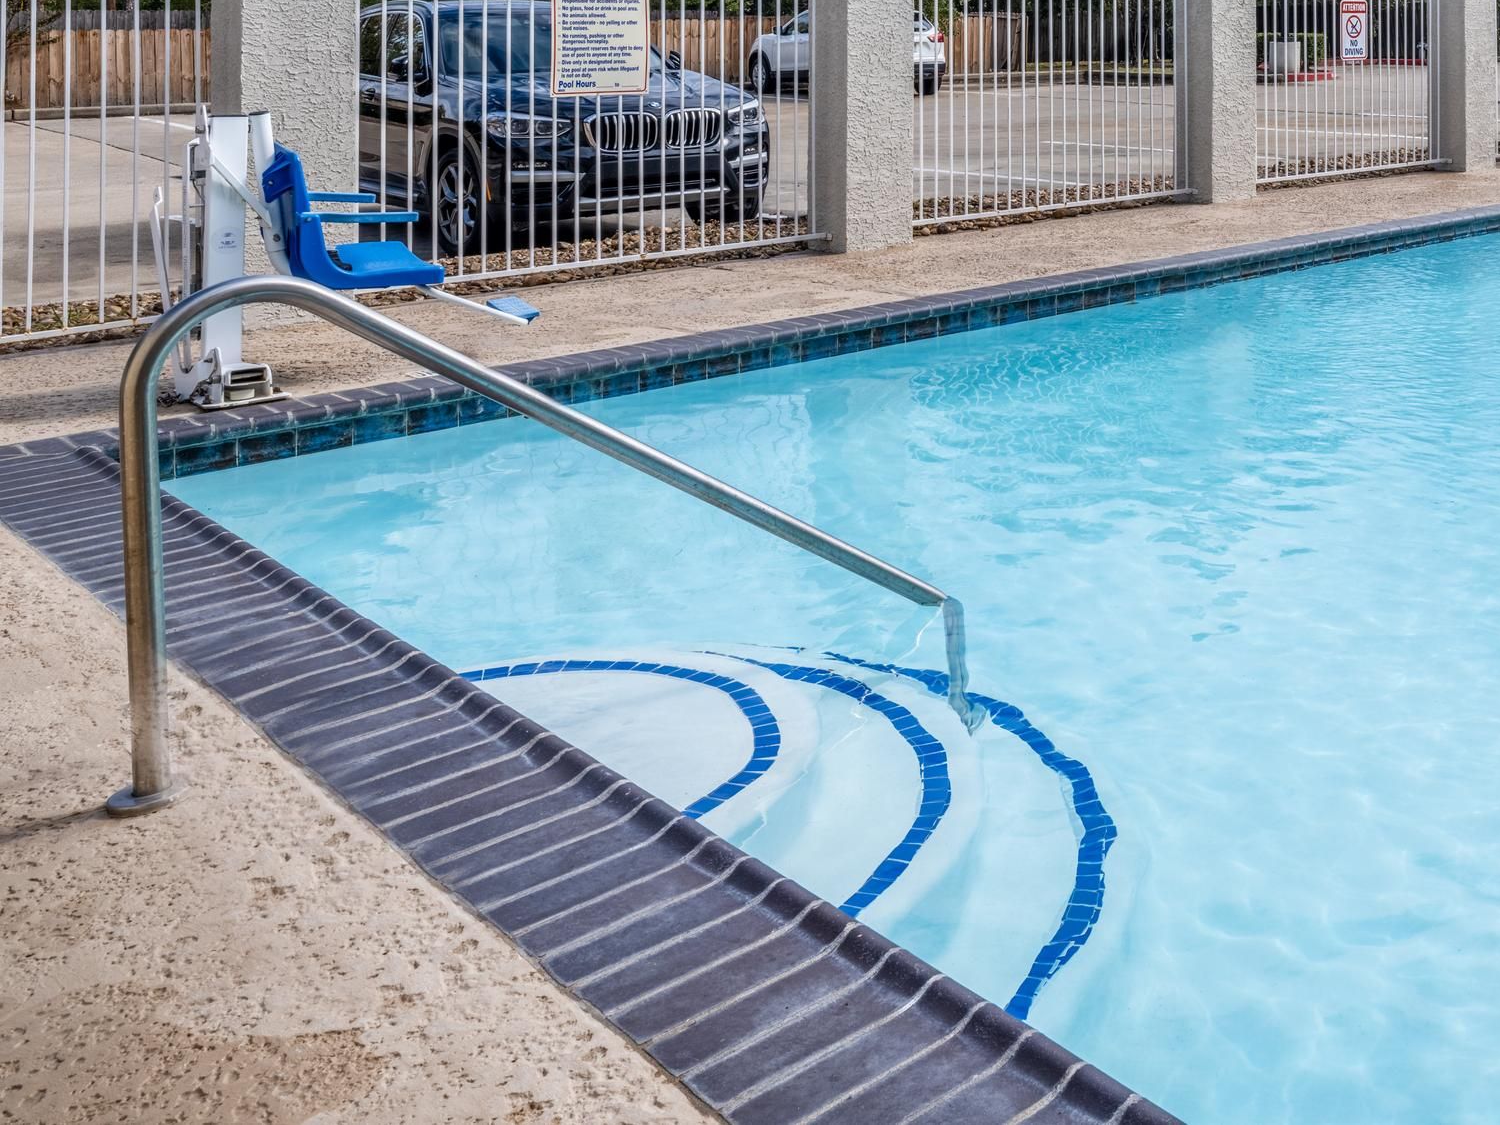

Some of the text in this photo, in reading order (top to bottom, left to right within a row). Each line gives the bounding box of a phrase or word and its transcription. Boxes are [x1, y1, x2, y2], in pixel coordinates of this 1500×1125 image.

[1343, 3, 1365, 11] ATTENTION
[1350, 39, 1358, 47] NO
[1345, 48, 1363, 56] DIVING
[559, 80, 574, 88] Pool
[576, 80, 596, 88] Hours
